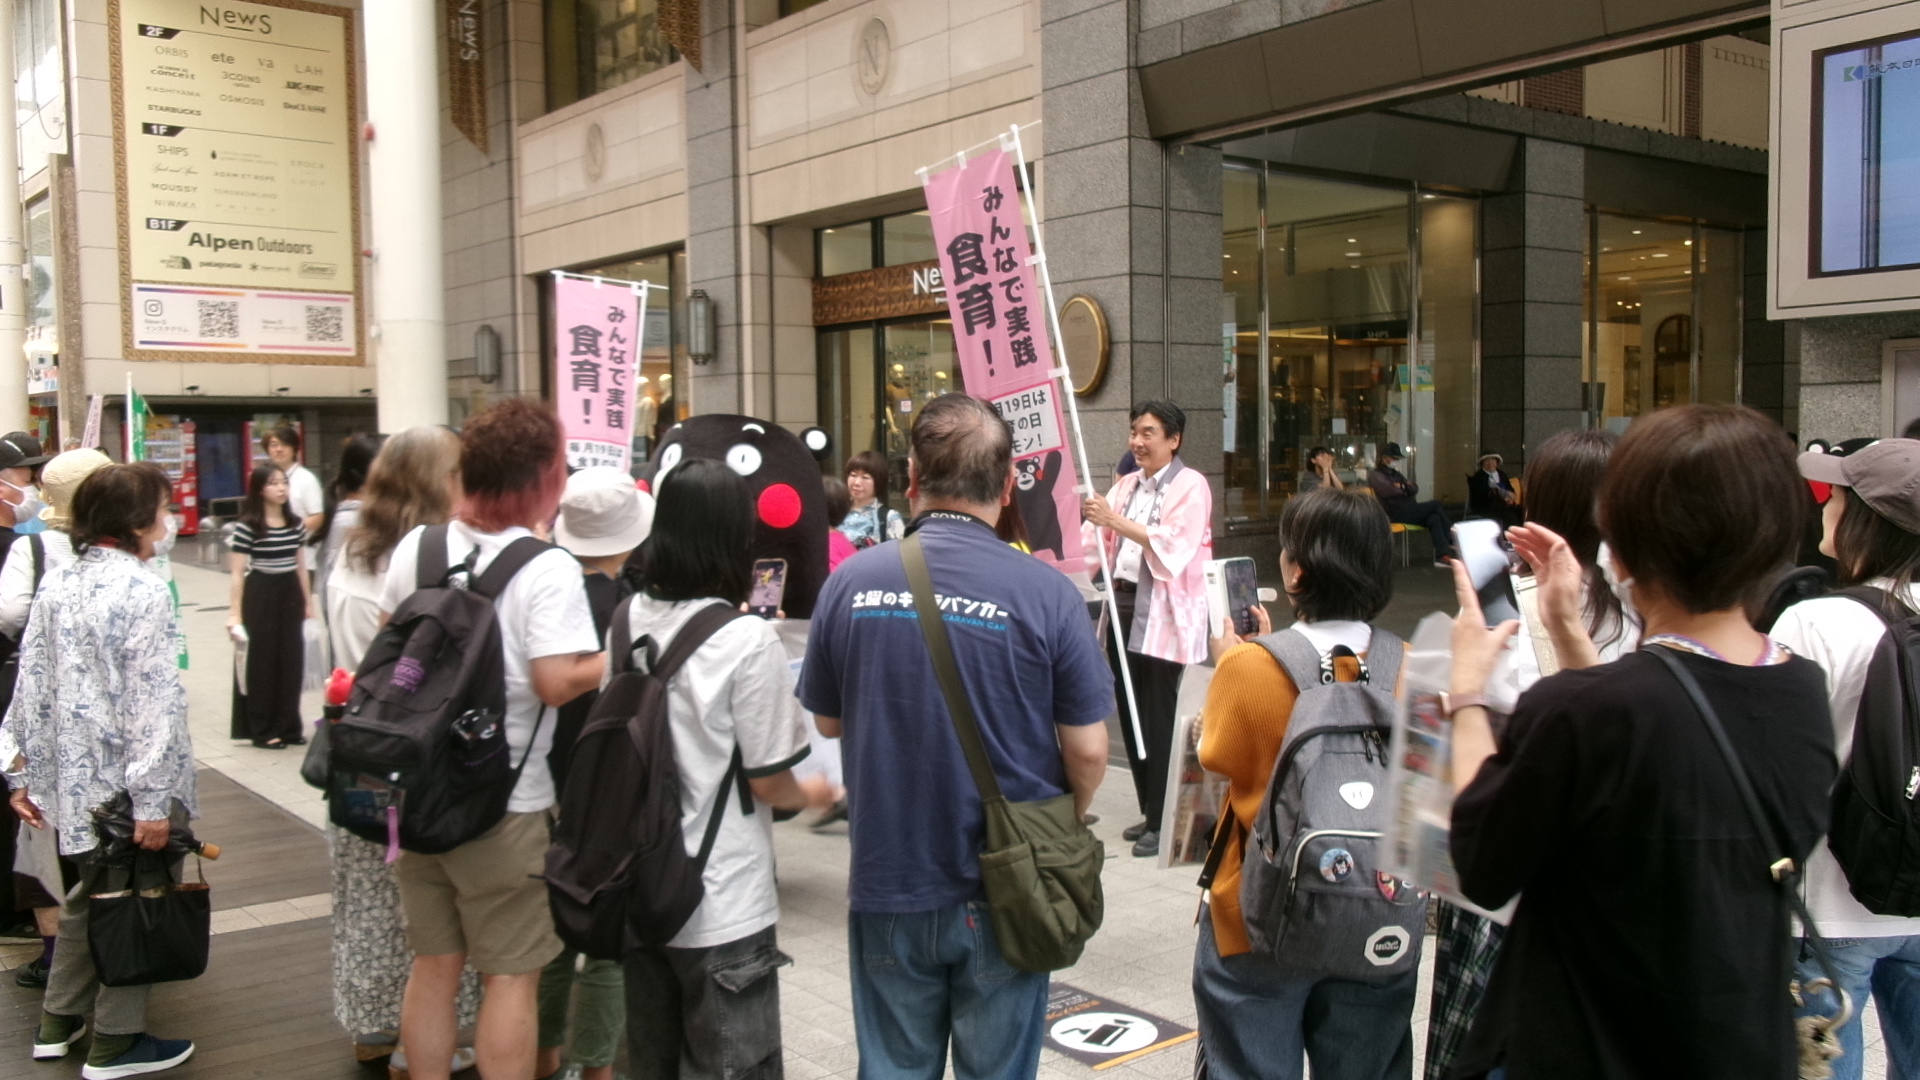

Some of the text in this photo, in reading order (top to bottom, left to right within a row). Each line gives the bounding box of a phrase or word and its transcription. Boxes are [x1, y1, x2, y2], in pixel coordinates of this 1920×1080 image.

[146, 26, 164, 37] 2F
[155, 45, 189, 58] ORBIS
[211, 53, 235, 64] ete
[222, 71, 261, 84] 3COINS
[146, 86, 201, 97] KASHIYAMA
[219, 94, 265, 106] OSMOSIS
[147, 104, 202, 116] STARBUCKS
[151, 124, 168, 135] 1F
[157, 144, 189, 157] SHIPS
[151, 183, 197, 193] MOUSSY
[154, 199, 197, 209] NIWAKA
[150, 219, 176, 230] B1F
[188, 232, 313, 255] Alpen Outdoors
[983, 186, 1037, 368] みんなで実践
[946, 232, 996, 377] 食育！
[1366, 330, 1390, 339] SHIPS
[607, 306, 627, 430] みんなで実践
[568, 325, 603, 425] 食育！
[942, 613, 984, 627] CARAVAN
[986, 622, 1007, 631] CAR
